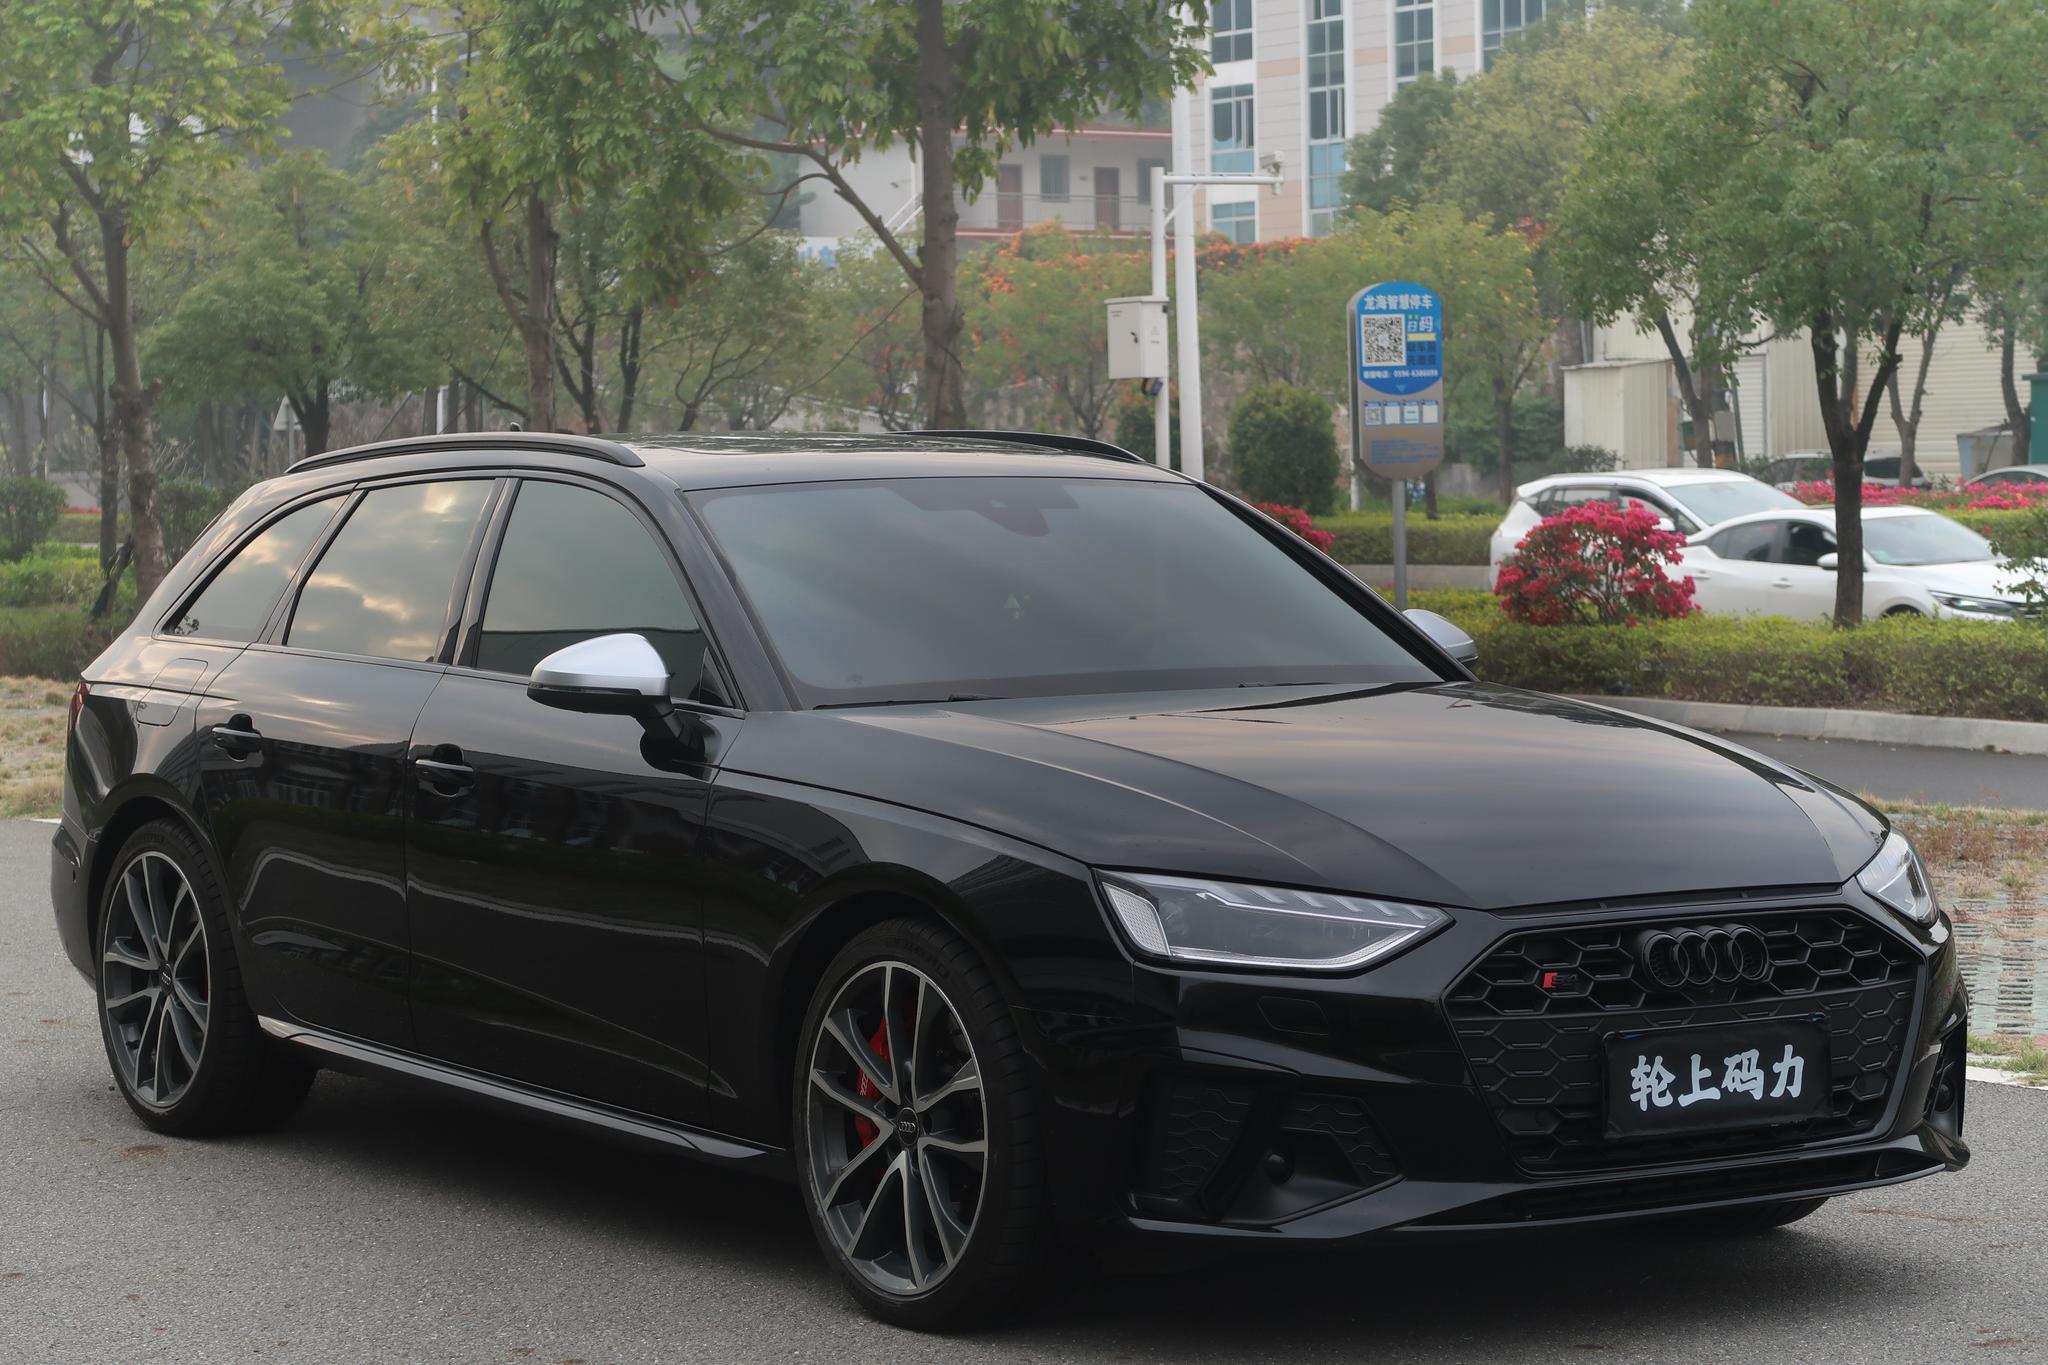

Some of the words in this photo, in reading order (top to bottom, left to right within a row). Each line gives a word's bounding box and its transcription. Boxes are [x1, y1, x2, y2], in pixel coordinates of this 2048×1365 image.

[1364, 294, 1433, 310] 龙海智慧停车
[1630, 1044, 1805, 1111] 轮上码力
